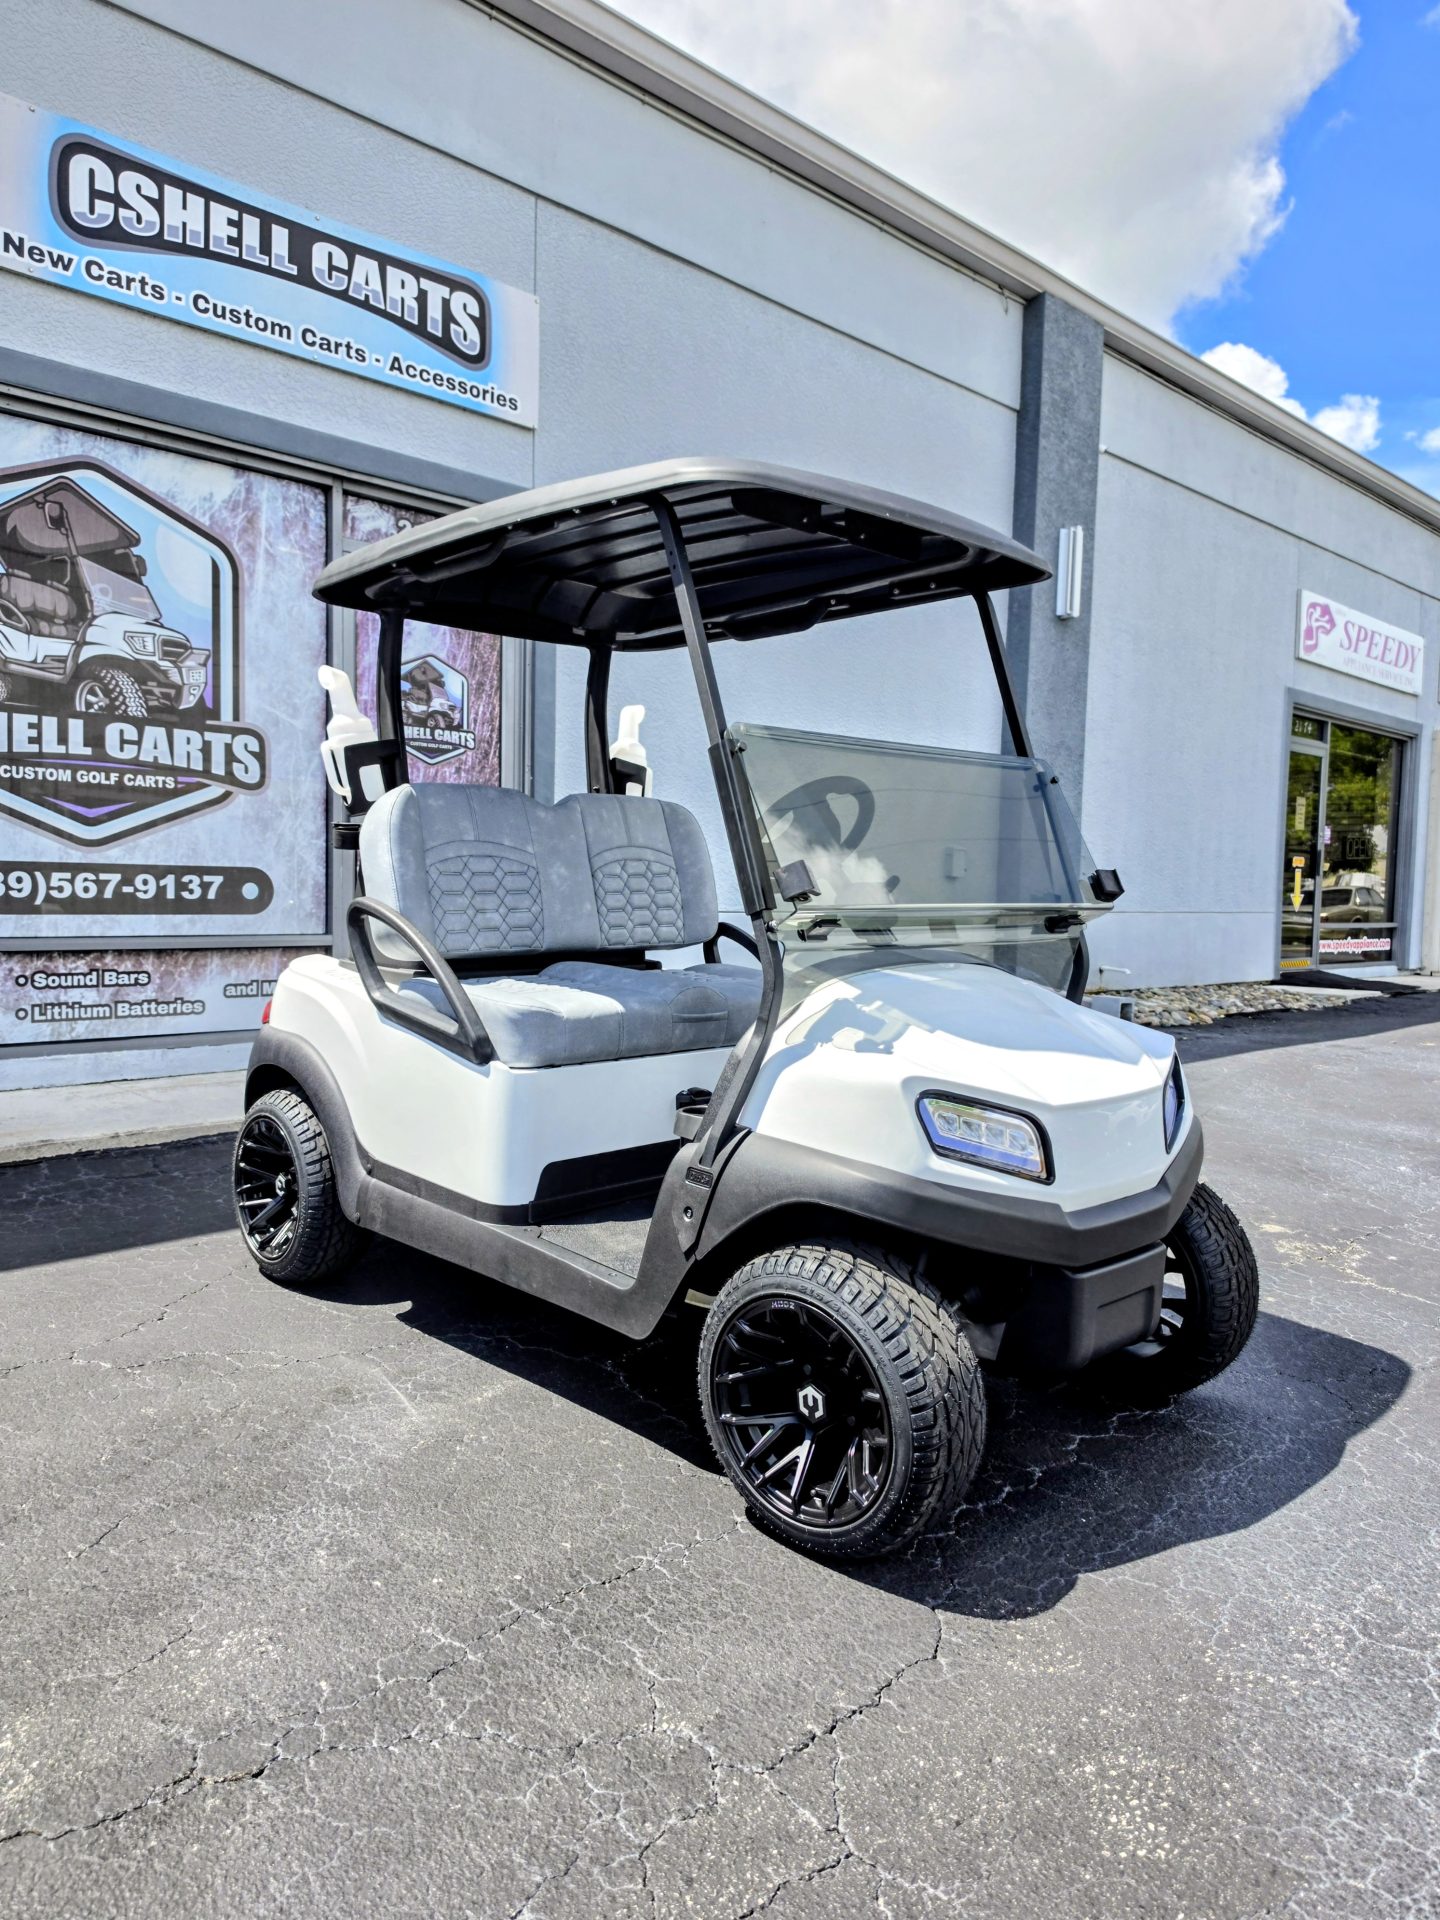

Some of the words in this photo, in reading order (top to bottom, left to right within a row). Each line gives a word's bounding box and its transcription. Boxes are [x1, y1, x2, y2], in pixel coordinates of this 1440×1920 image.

[68, 152, 298, 275] CSHELL
[311, 242, 481, 356] CARTS
[3, 231, 74, 272] New
[85, 259, 166, 301] Carts
[192, 294, 291, 340] Custom
[302, 327, 367, 364] Carts
[389, 355, 519, 411] Accessories
[1340, 620, 1421, 672] SPEEDY
[0, 712, 92, 755] ELL
[105, 722, 261, 784] CARTS
[434, 728, 475, 749] CARTS
[0, 764, 71, 782] CUSTOM
[76, 770, 119, 785] GOLF
[127, 773, 175, 789] CARTS
[0, 870, 224, 905] 9)567-9137
[33, 970, 98, 987] Sound
[104, 971, 150, 985] Bars
[225, 981, 257, 996] and
[33, 1002, 111, 1021] Lithium
[117, 999, 204, 1017] Batteries
